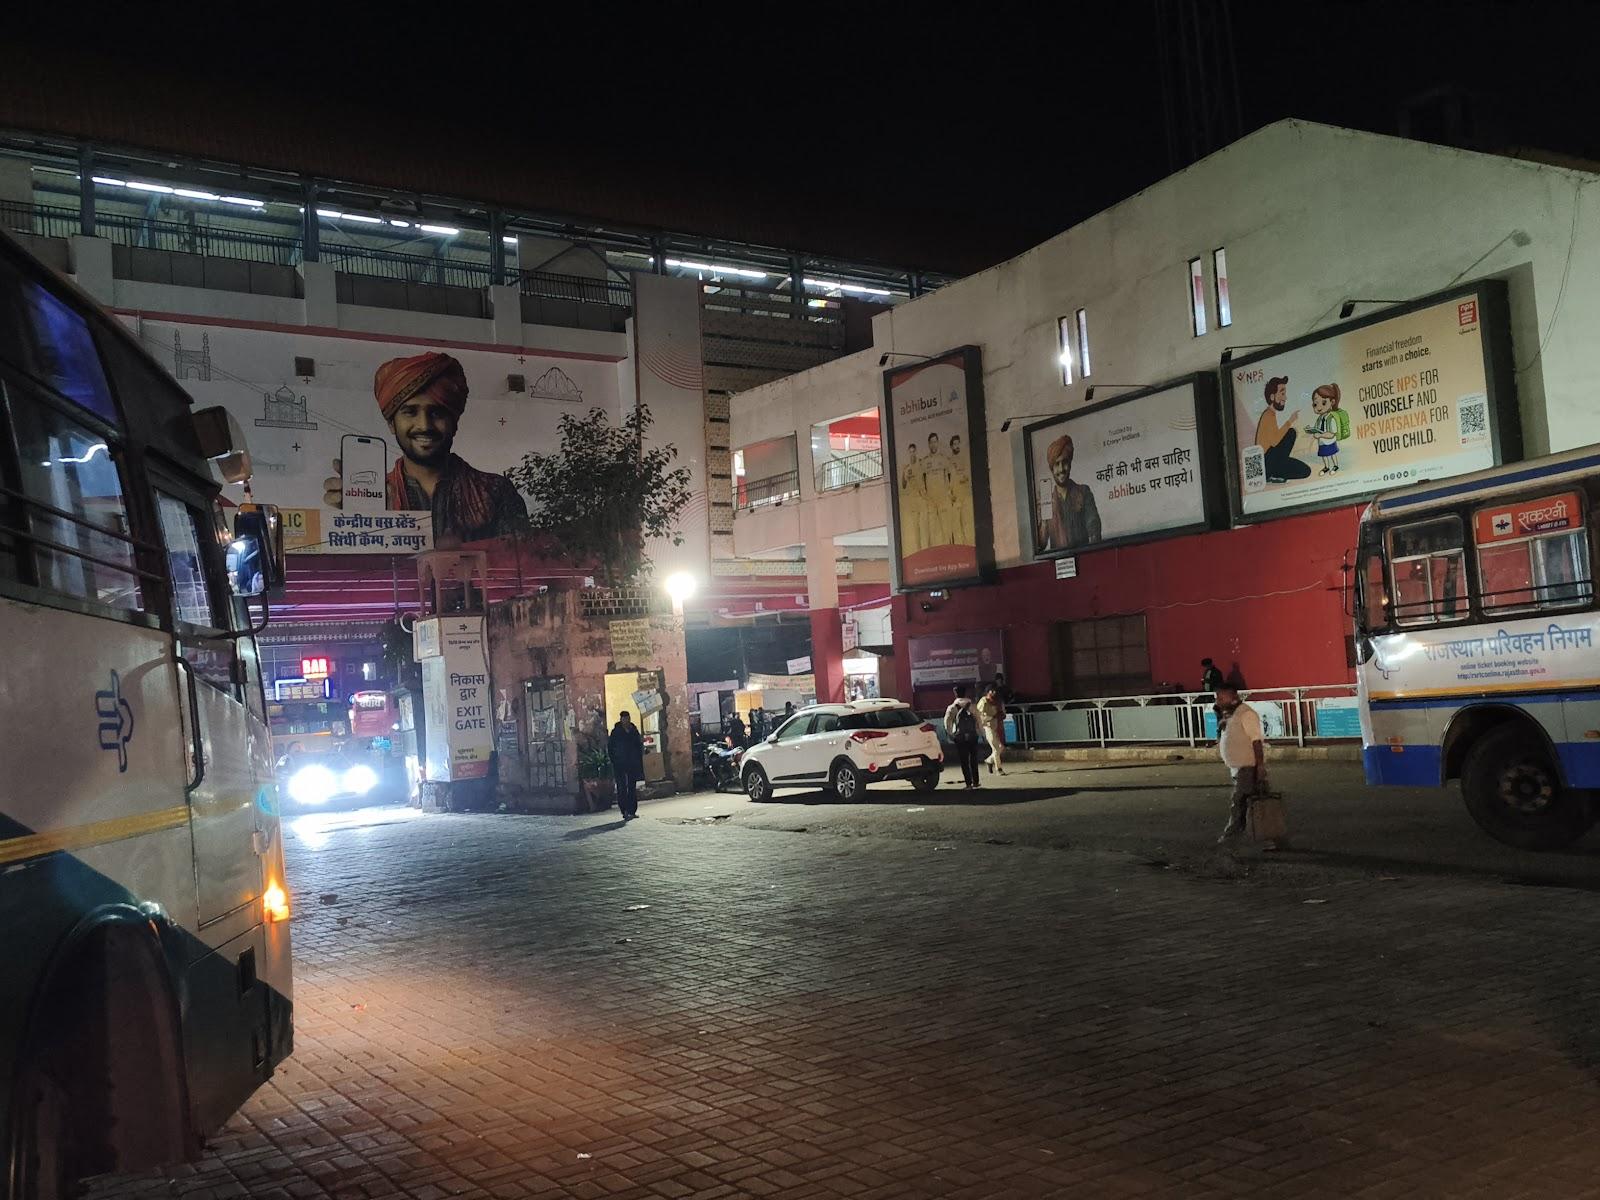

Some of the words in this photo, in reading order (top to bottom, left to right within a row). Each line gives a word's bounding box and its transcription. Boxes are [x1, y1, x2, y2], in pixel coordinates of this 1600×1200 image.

[1366, 341, 1394, 358] Financial
[1395, 335, 1423, 350] freedom
[1361, 359, 1383, 373] starts
[1384, 354, 1398, 367] with
[1400, 354, 1404, 363] a
[1359, 380, 1395, 402] CHOOSE
[1396, 374, 1418, 392] NPS
[1420, 368, 1439, 387] FOR
[900, 397, 938, 416] abhibus
[1363, 394, 1414, 420] YOURSELF
[1416, 388, 1437, 407] AND
[1356, 422, 1376, 440] NPS
[1378, 410, 1427, 434] VATSALYA
[1429, 405, 1449, 423] FOR
[1373, 436, 1401, 455] YOUR
[1402, 428, 1437, 448] CHILD.
[1096, 463, 1113, 482] कहीं
[1116, 461, 1128, 478] की
[1130, 457, 1143, 473] भी
[1144, 457, 1159, 470] बस
[1162, 447, 1191, 466] चाहिए
[345, 488, 383, 499] abhibus
[1108, 482, 1147, 500] abhibus
[1149, 477, 1161, 490] पर
[283, 514, 302, 528] IC
[333, 512, 373, 529] केन्द्रीय
[375, 517, 393, 529] बस
[1518, 500, 1568, 531] सकरनी
[328, 531, 359, 547] सिंधी
[391, 535, 427, 550] जयपुर
[1423, 638, 1484, 661] राजस्थान
[1485, 629, 1546, 655] परिवहन
[1547, 623, 1592, 651] निगम
[302, 658, 328, 673] BAR
[1477, 660, 1493, 669] ticket
[1494, 659, 1516, 670] booking
[1517, 658, 1539, 667] website
[450, 672, 485, 687] निकास
[460, 687, 478, 701] द्वार
[456, 705, 482, 718] EXIT
[455, 718, 486, 731] GATE
